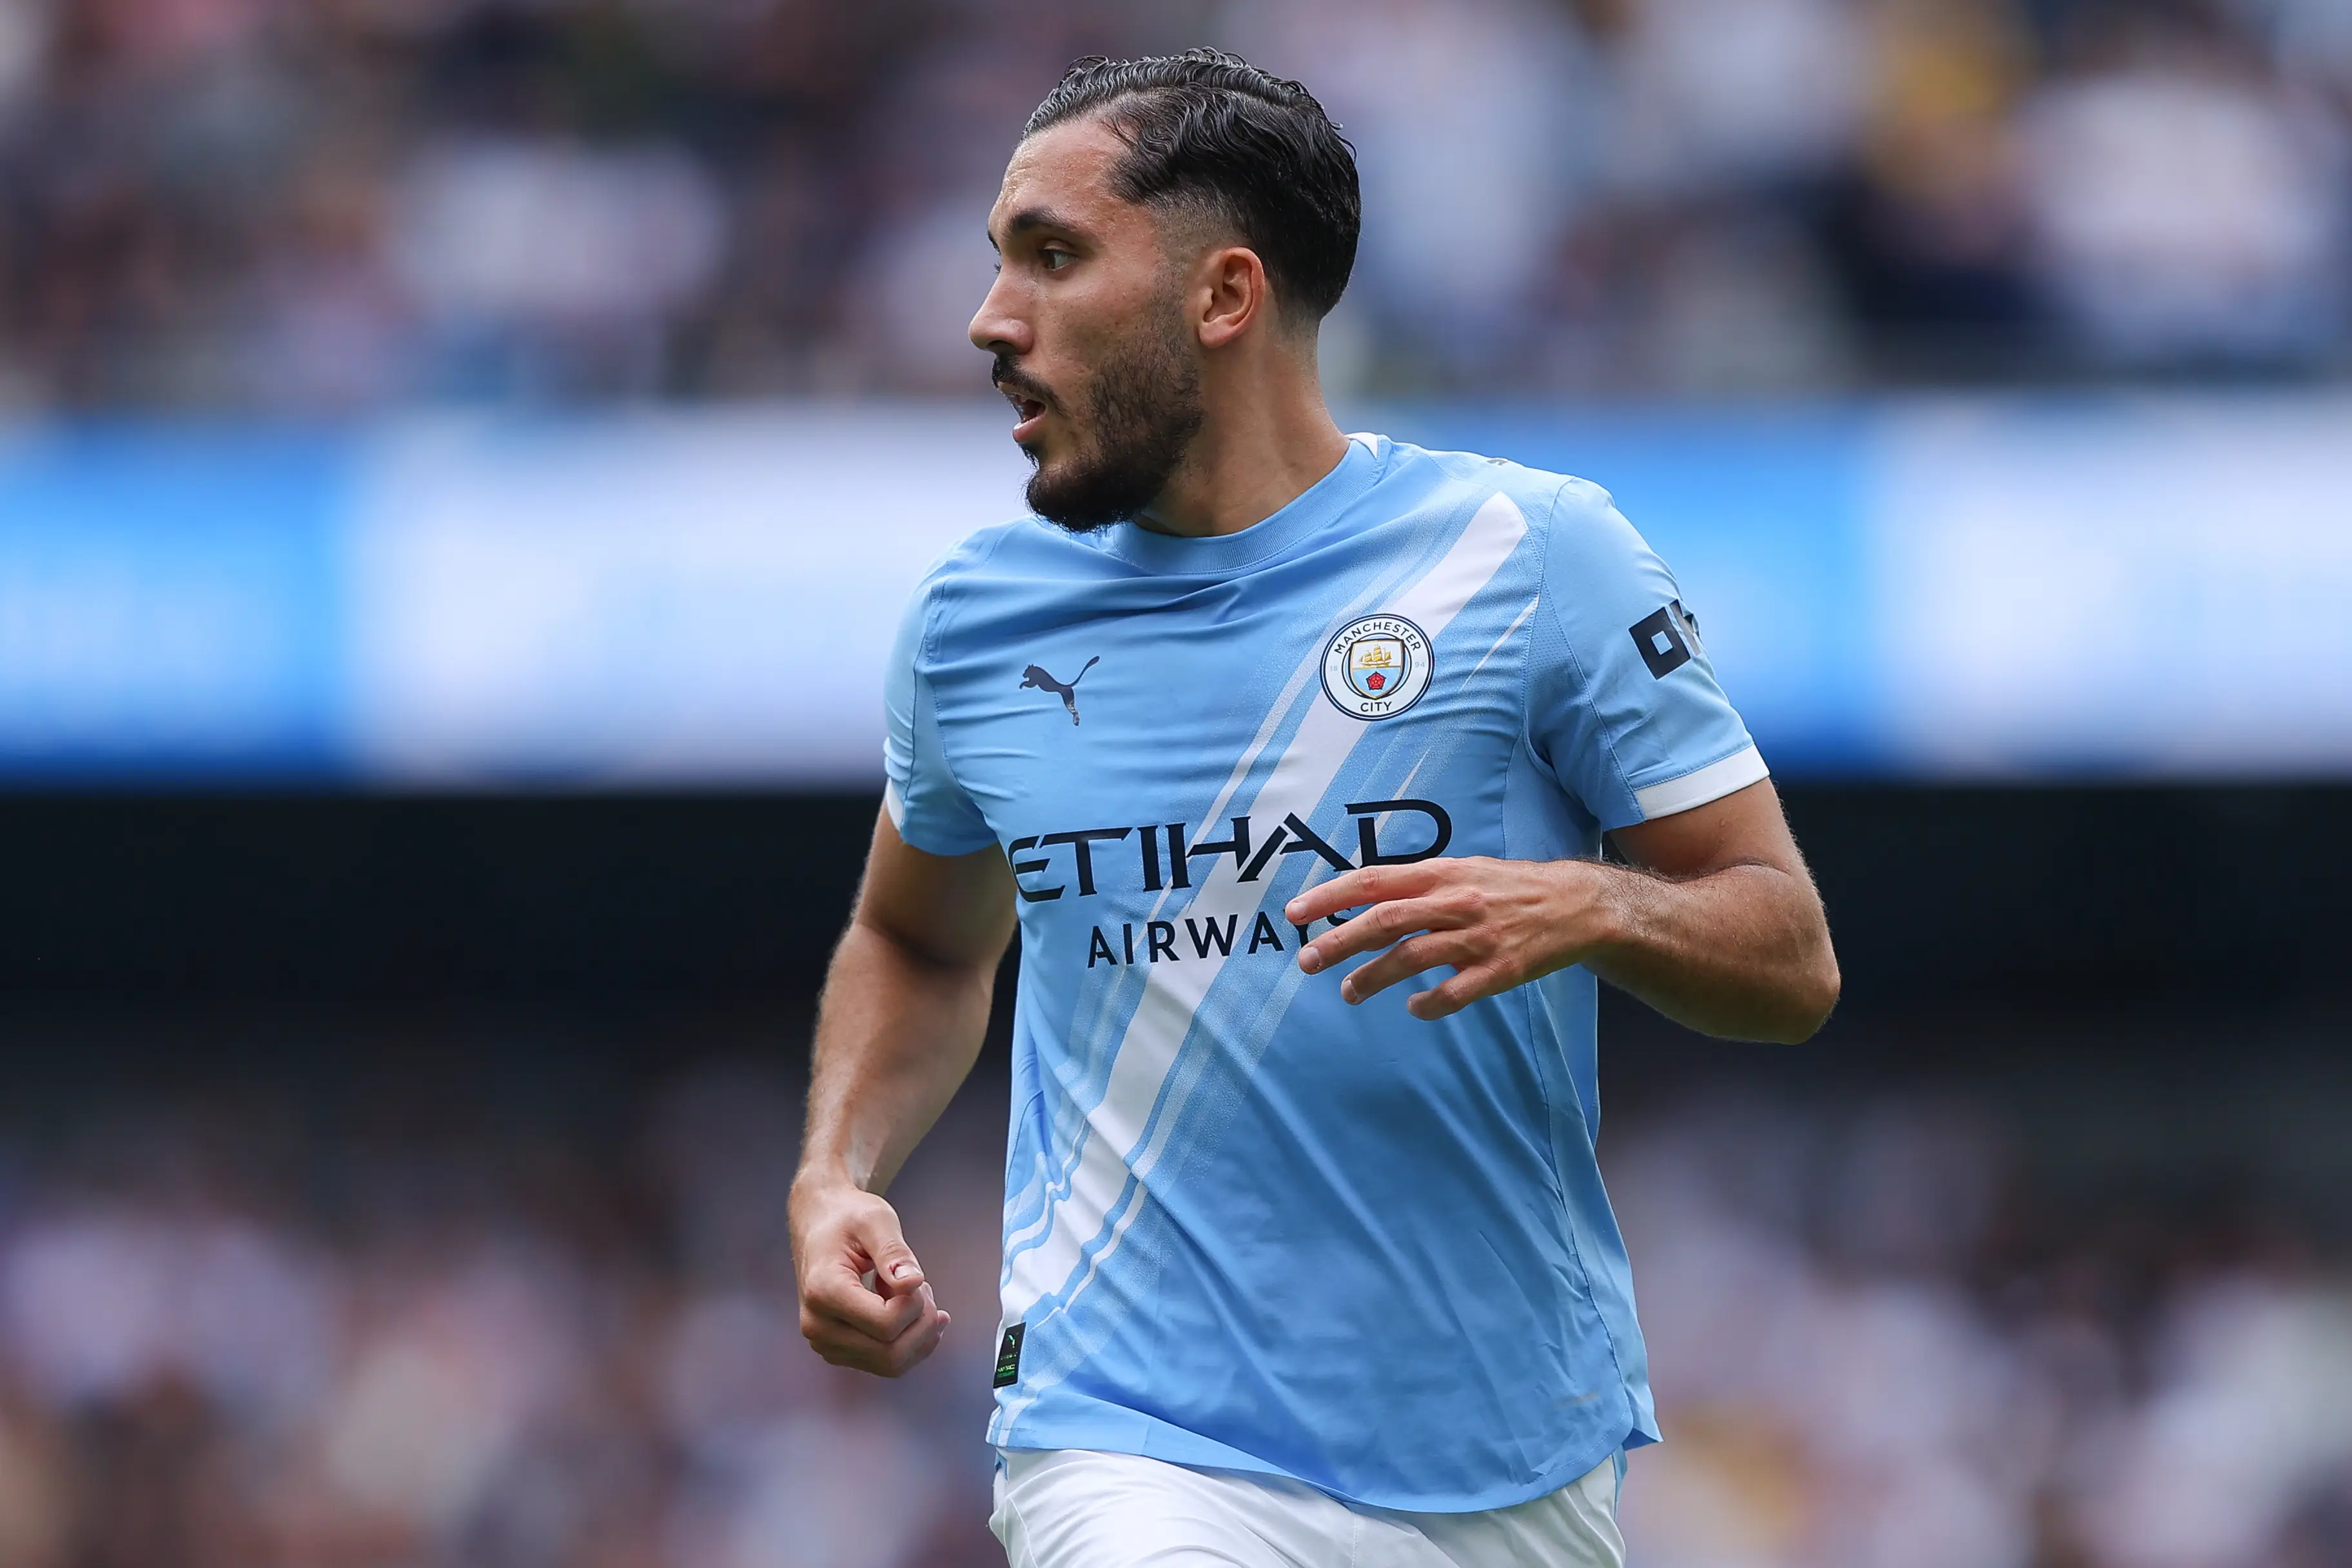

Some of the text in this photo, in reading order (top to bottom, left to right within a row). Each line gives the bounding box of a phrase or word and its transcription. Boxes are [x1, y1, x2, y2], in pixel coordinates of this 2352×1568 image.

[1334, 622, 1421, 654] MANCHESTER
[1360, 701, 1393, 713] CITY
[1008, 799, 1453, 903] ETIHAD
